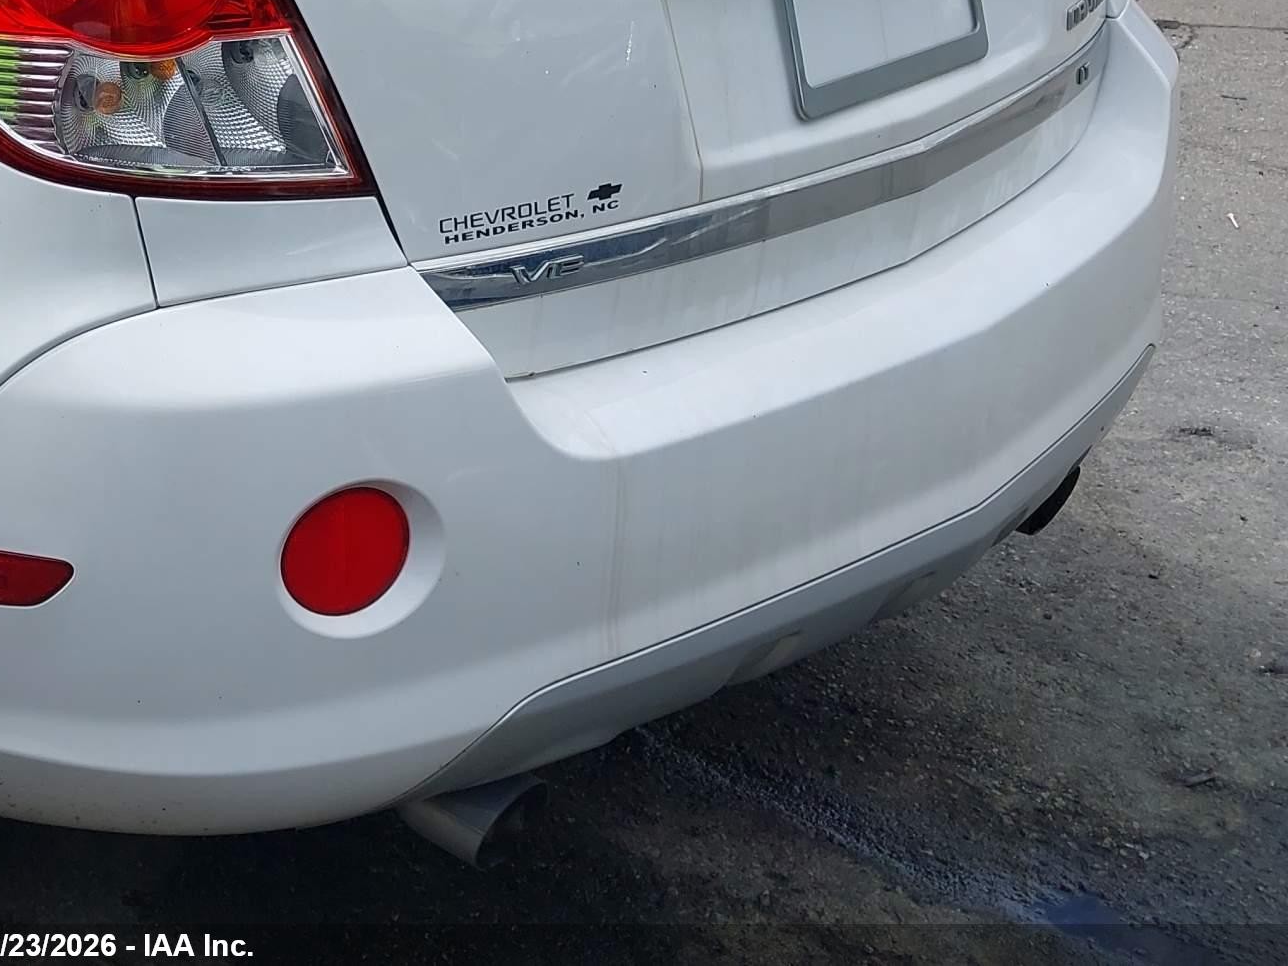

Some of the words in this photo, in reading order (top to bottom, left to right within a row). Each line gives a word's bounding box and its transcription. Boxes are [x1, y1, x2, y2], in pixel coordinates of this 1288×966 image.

[439, 193, 575, 234] CHEVROLET
[444, 209, 586, 245] HENDERSON,
[592, 200, 620, 214] NC
